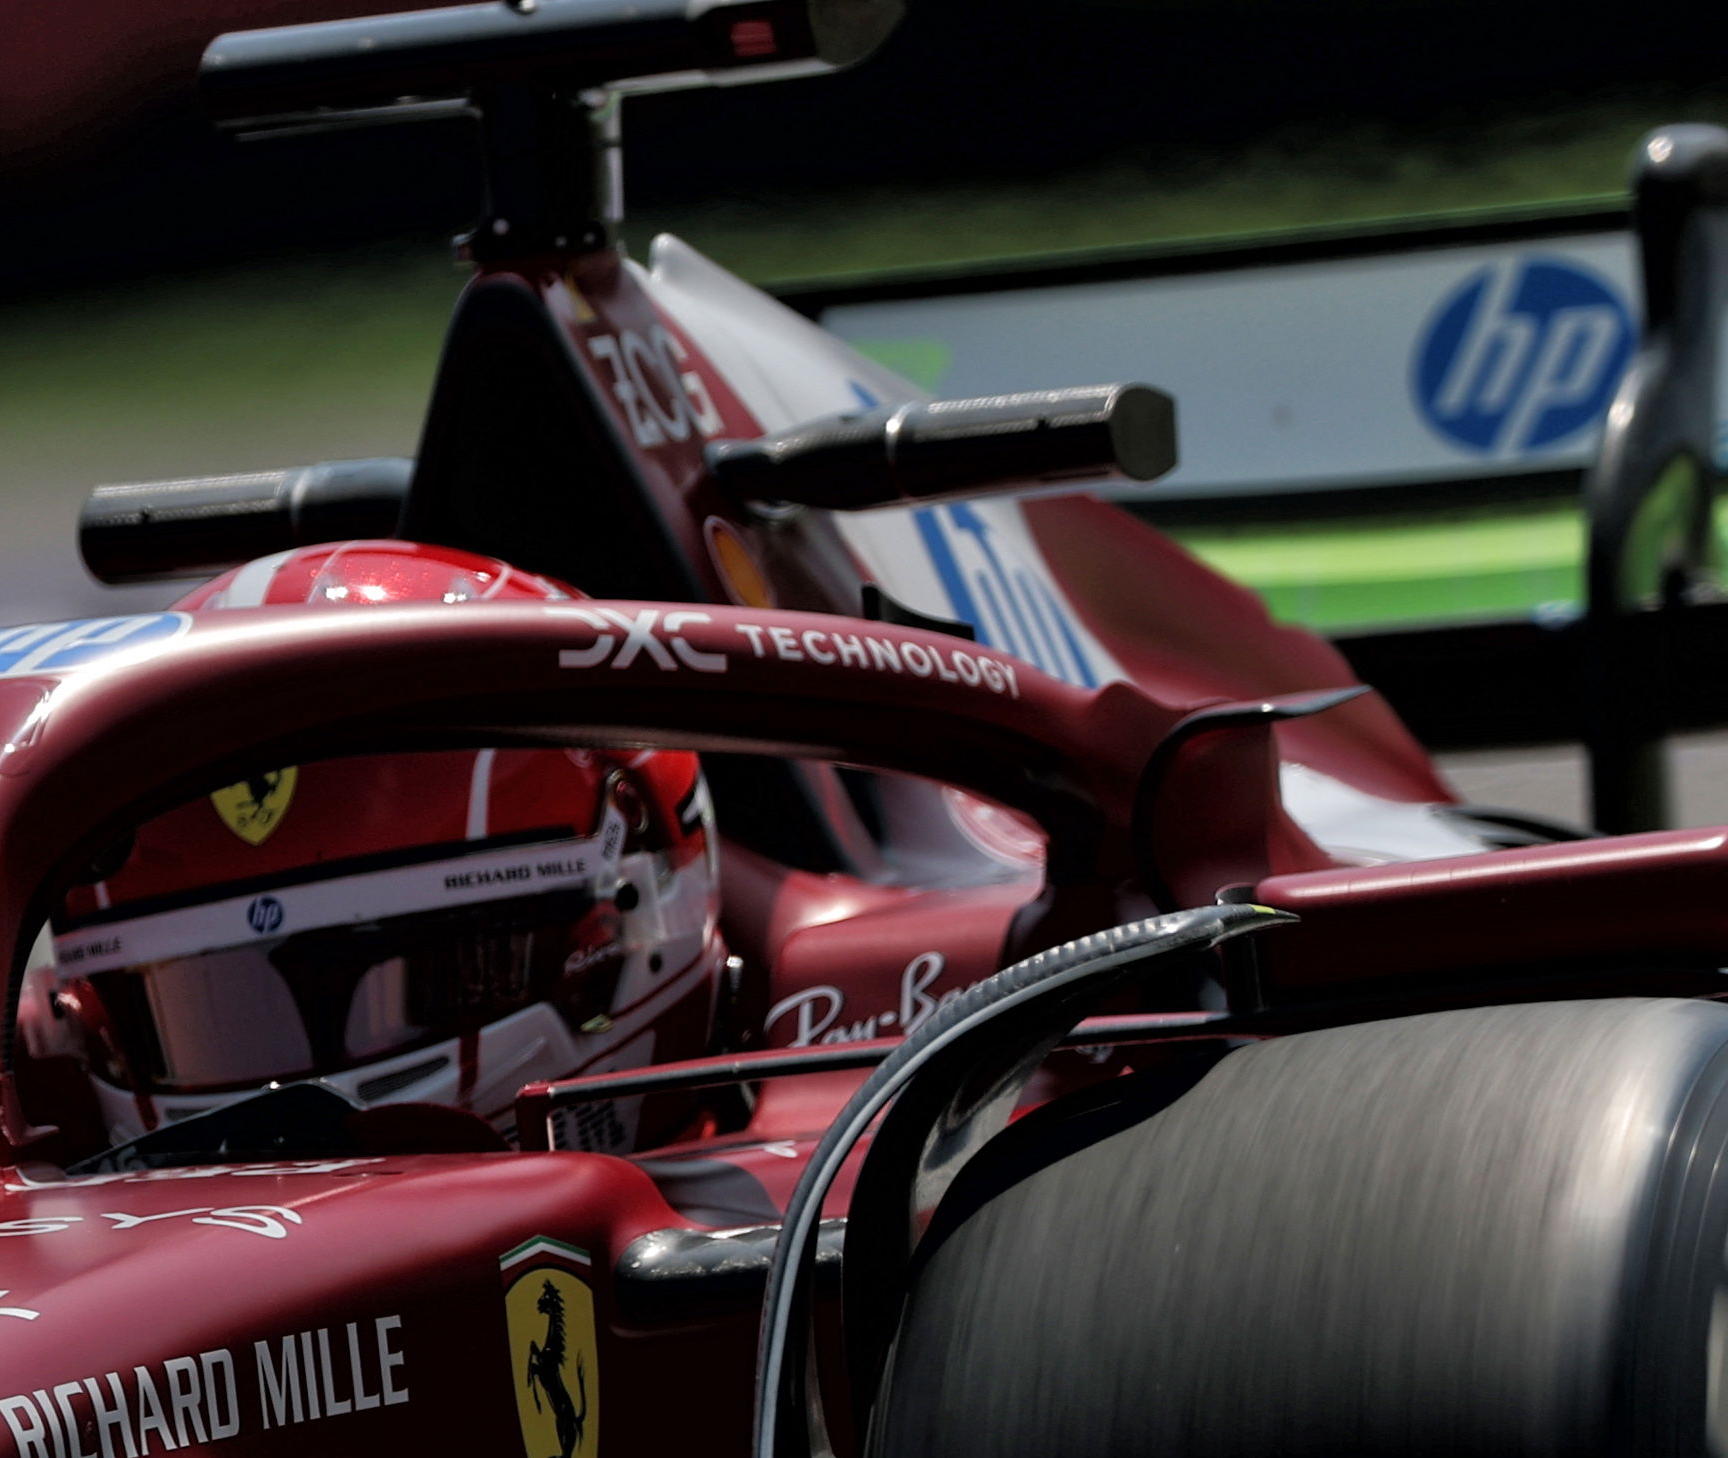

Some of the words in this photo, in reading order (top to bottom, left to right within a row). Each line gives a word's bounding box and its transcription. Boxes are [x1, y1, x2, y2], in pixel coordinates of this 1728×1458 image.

[1423, 255, 1631, 456] hp
[546, 606, 727, 673] DXC
[735, 621, 1019, 701] TECHNOLOGY
[247, 895, 284, 933] hp
[445, 865, 531, 889] RICHARD
[536, 860, 586, 878] MILLE
[254, 1315, 409, 1430] MILLE
